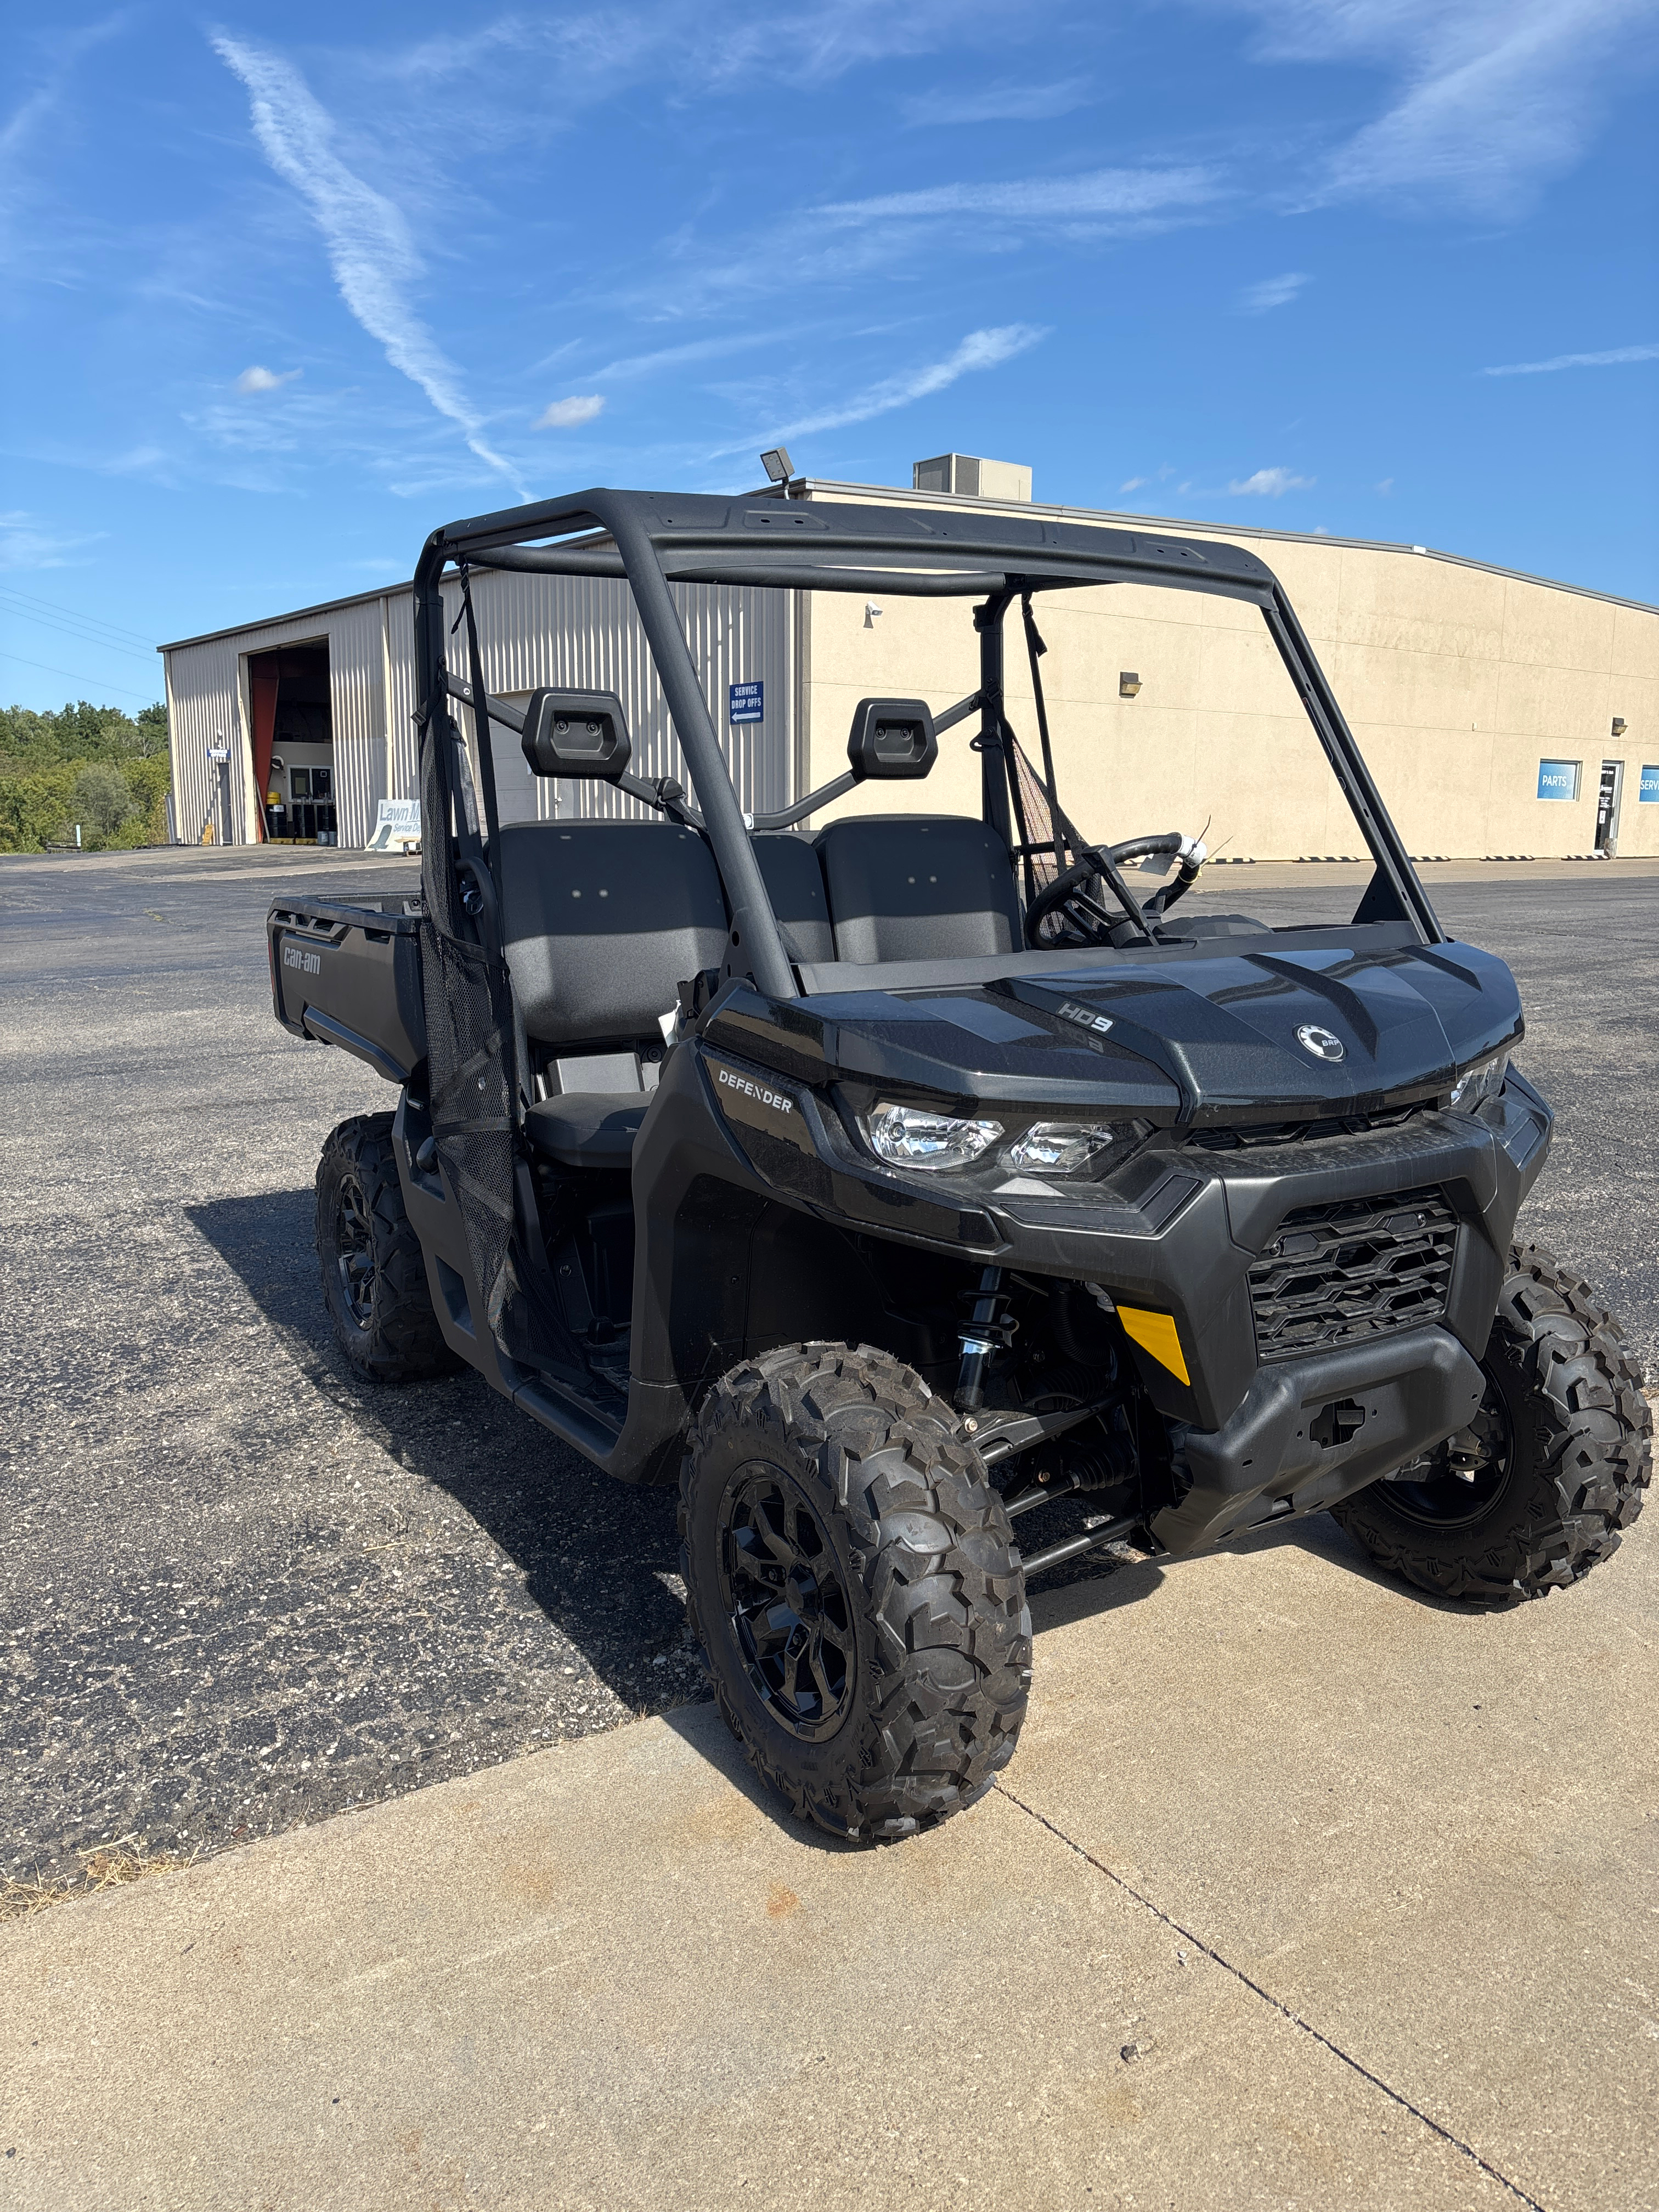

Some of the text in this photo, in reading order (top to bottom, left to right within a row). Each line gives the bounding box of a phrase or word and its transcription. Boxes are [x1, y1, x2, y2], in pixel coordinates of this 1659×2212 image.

[735, 685, 758, 697] SERVICE
[731, 697, 761, 709] DROP OFFS
[1542, 775, 1567, 787] PARTS
[380, 804, 408, 821] Lawn
[393, 823, 411, 832] Service
[284, 946, 321, 975] can-am
[1058, 1003, 1113, 1032] HD9
[719, 1069, 792, 1114] DEFENDER
